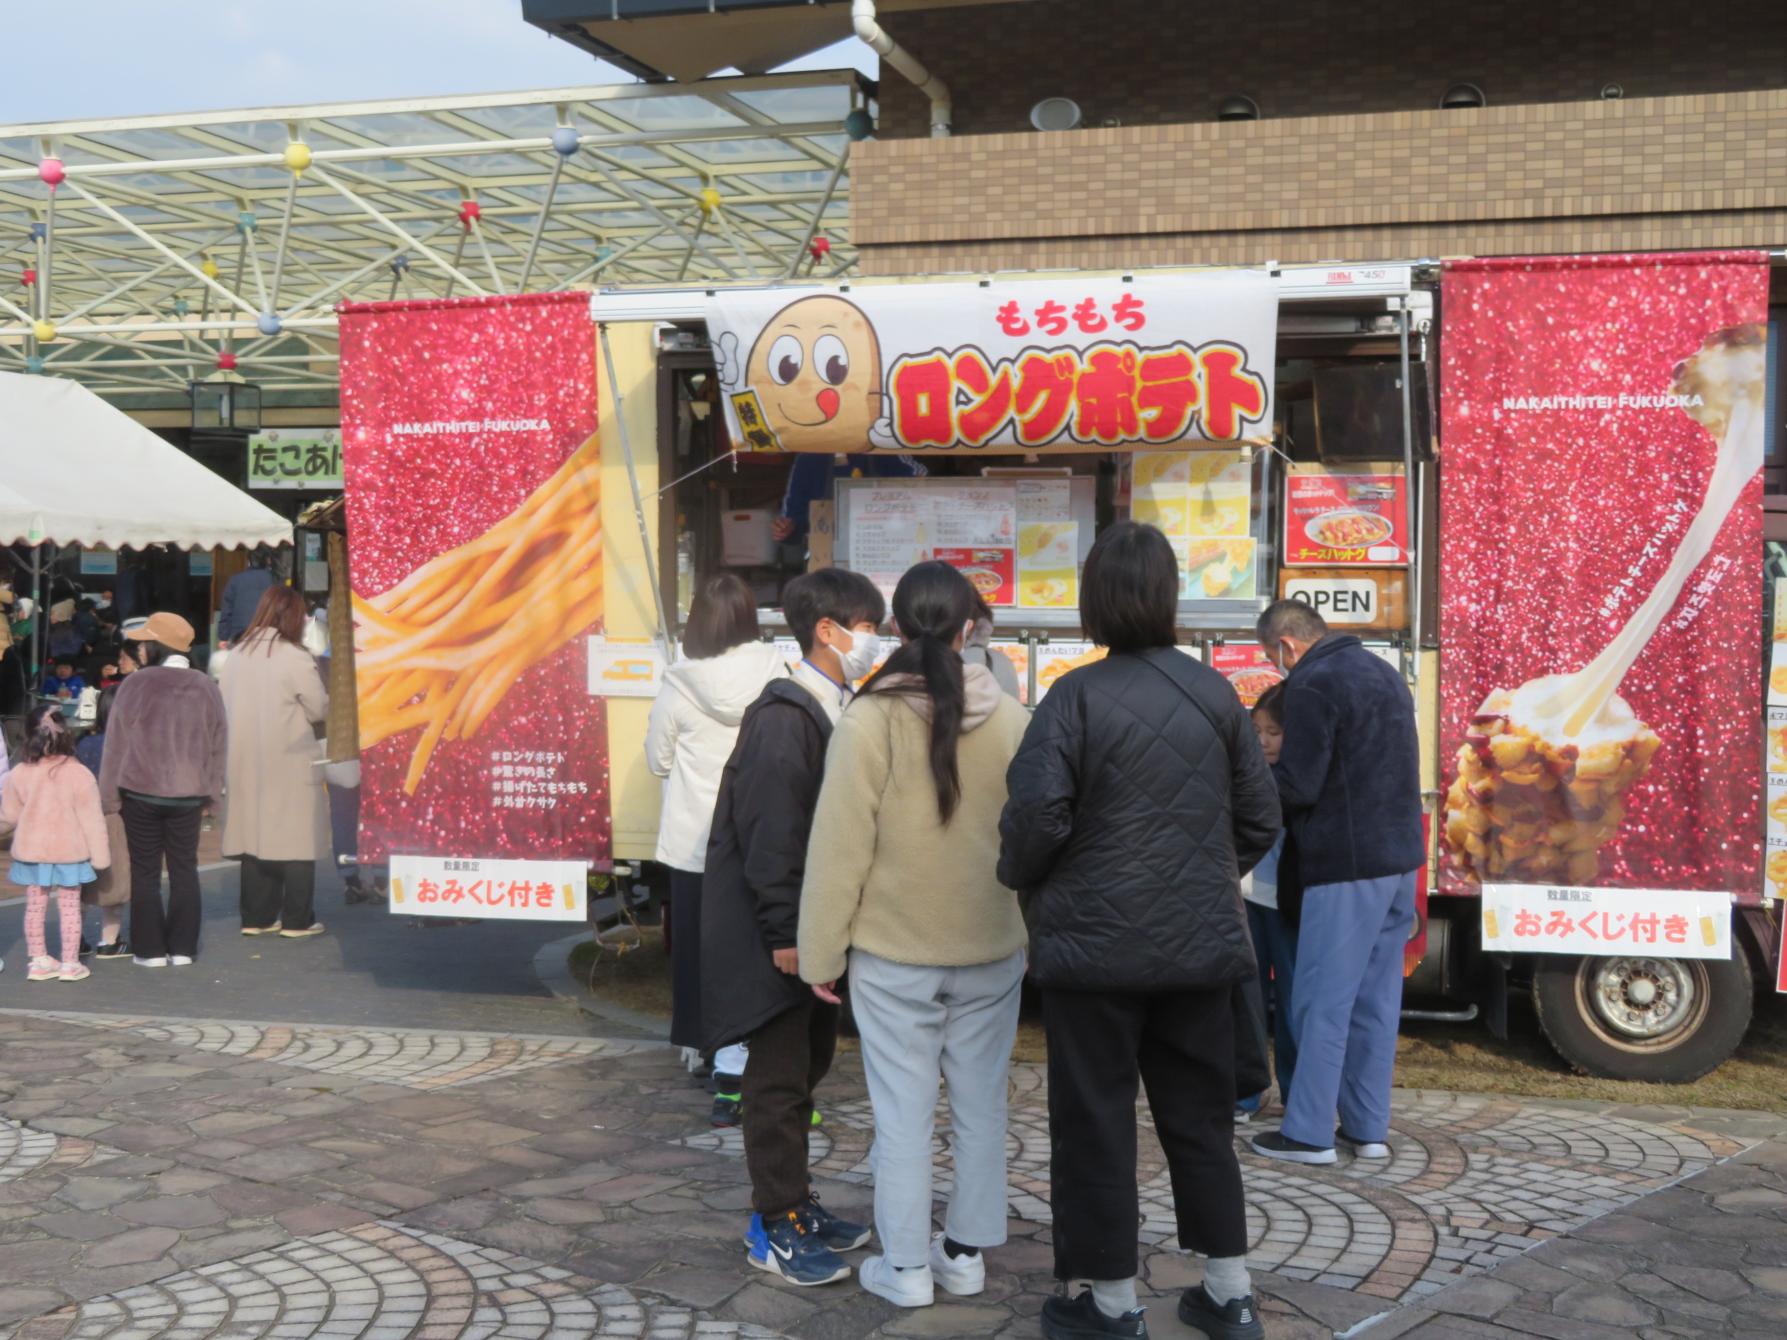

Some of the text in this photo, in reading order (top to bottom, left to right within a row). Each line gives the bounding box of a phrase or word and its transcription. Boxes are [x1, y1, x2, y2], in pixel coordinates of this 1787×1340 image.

[996, 293, 1146, 337] もちもち
[890, 345, 1265, 446] ロングポテト
[1618, 394, 1704, 408] FUKUOKA
[484, 419, 550, 432] FUKUOKA
[443, 861, 480, 872] 数量限定
[417, 877, 555, 908] おみくじ付き
[1547, 890, 1592, 902] 数量限定
[1513, 908, 1689, 943] おみくじ付き
